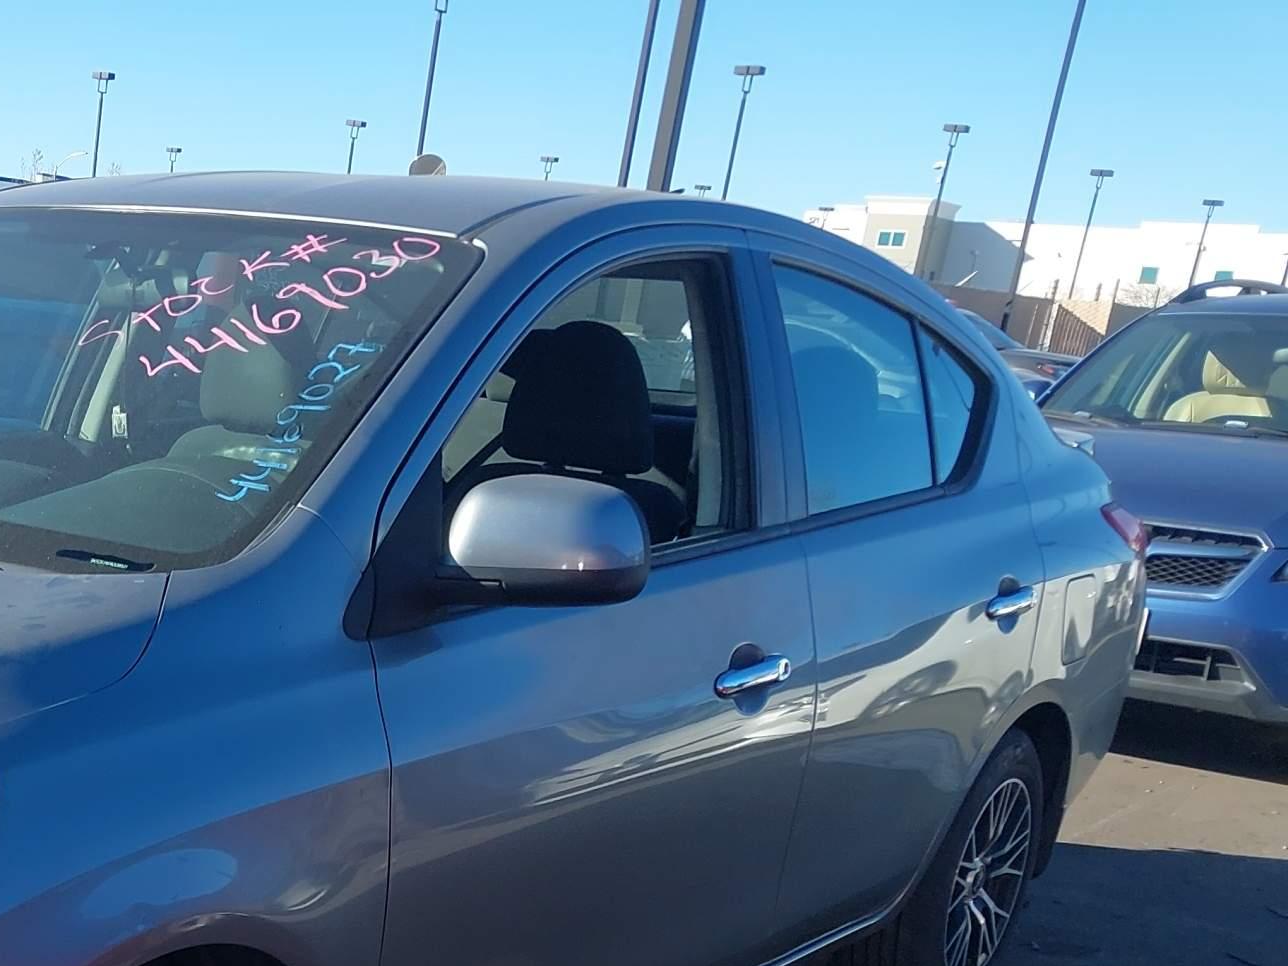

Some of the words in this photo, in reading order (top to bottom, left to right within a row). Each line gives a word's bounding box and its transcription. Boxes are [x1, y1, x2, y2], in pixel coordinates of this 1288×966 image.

[78, 234, 347, 346] STOCK#
[139, 237, 441, 377] 44169030
[215, 342, 385, 502] 44169027
